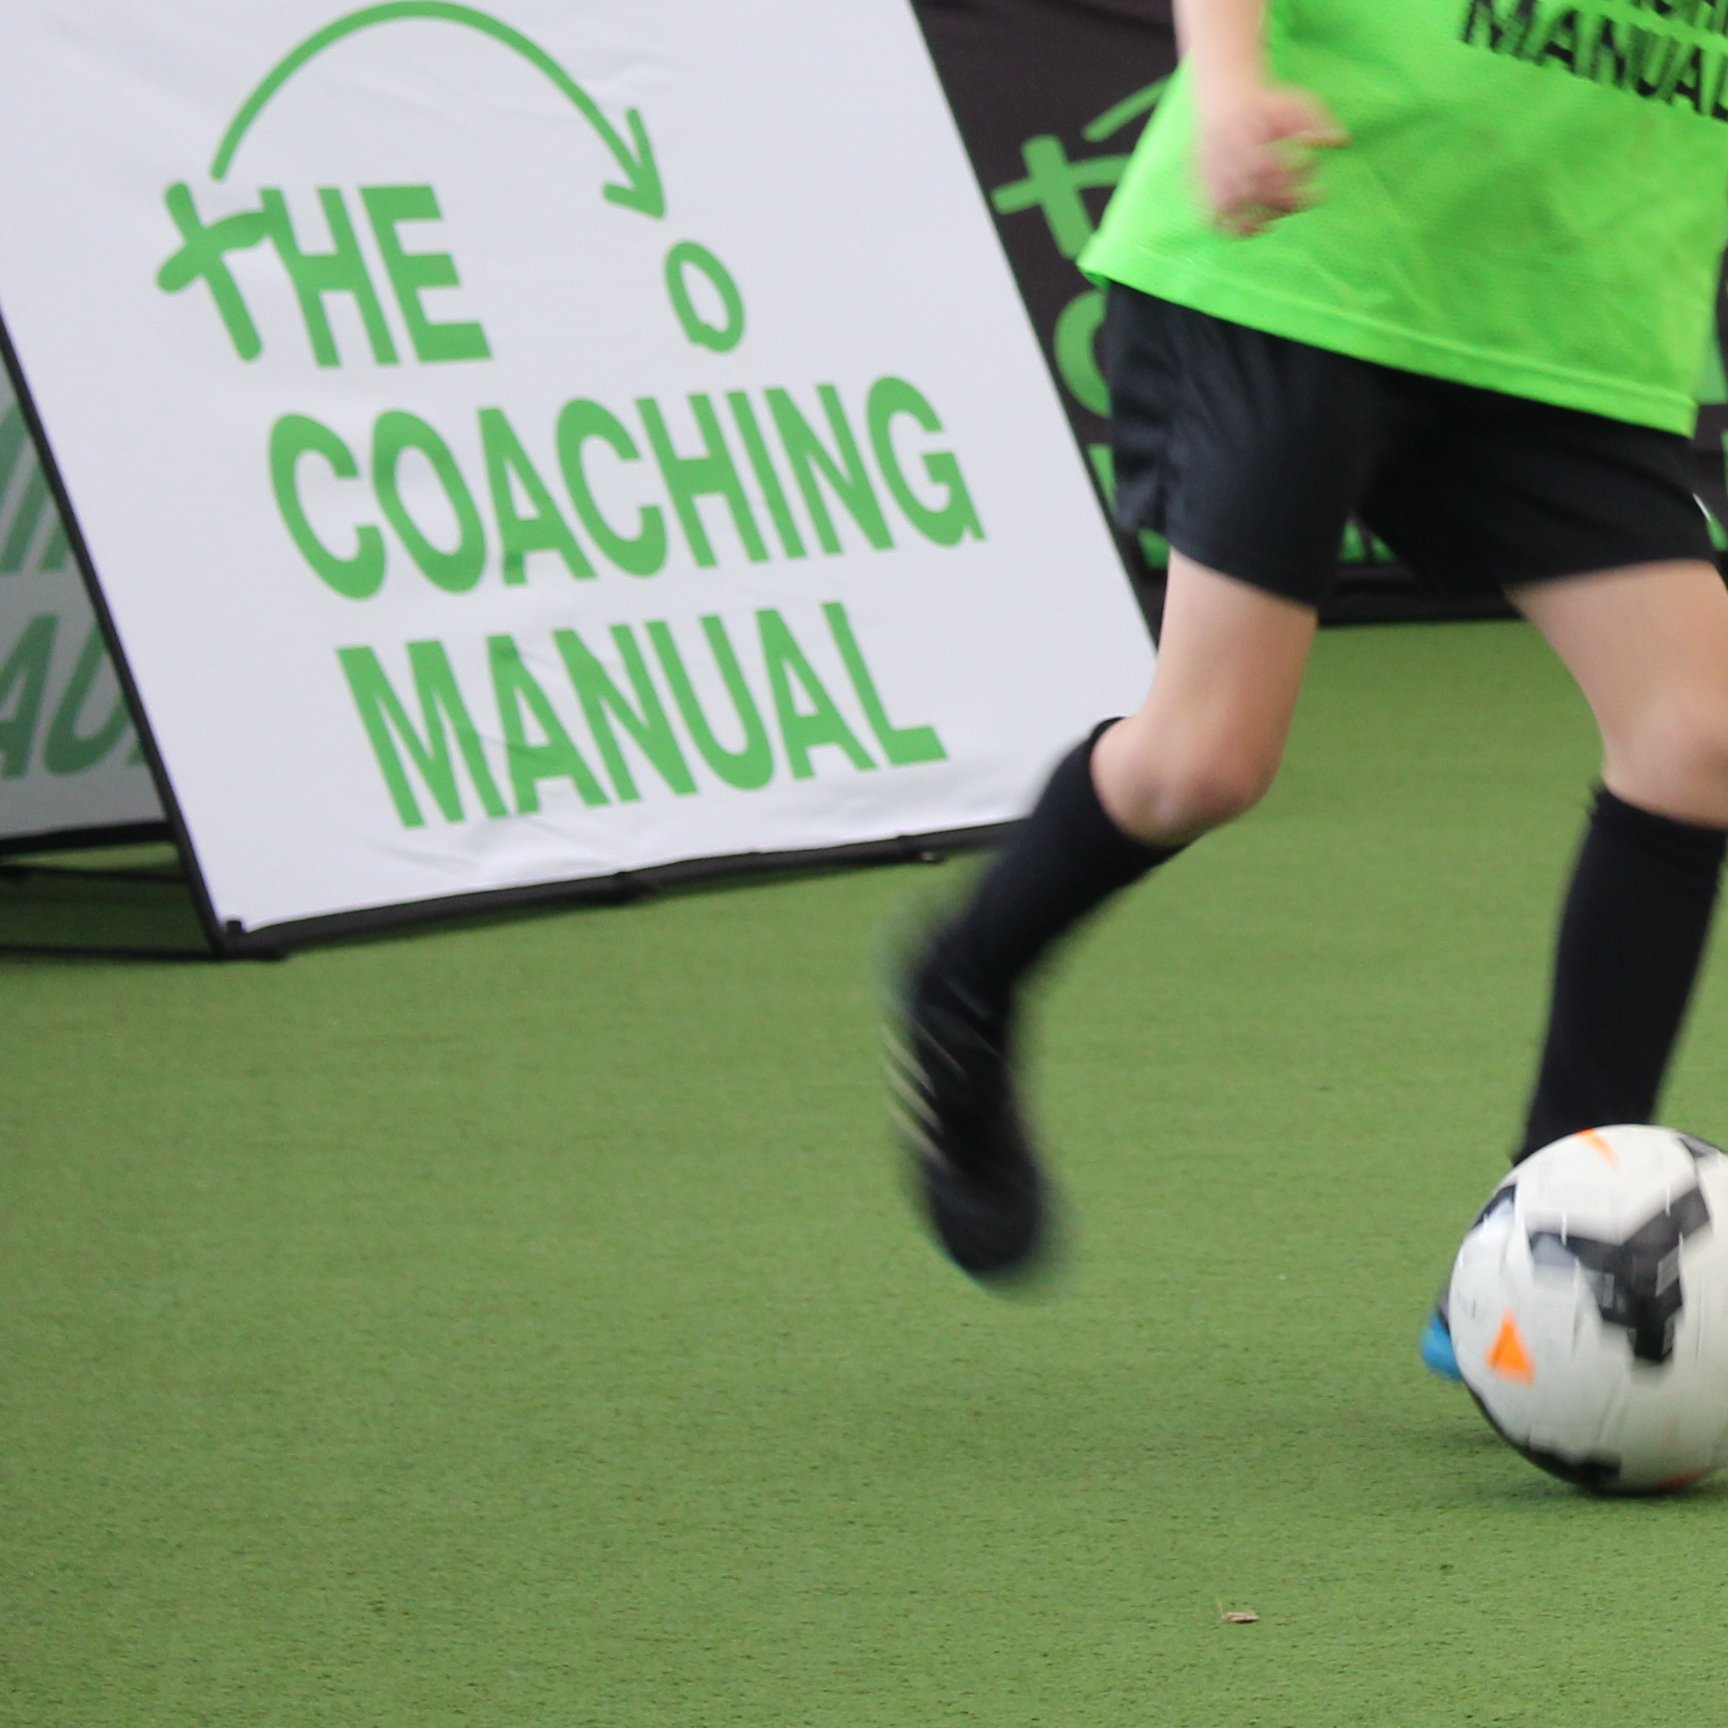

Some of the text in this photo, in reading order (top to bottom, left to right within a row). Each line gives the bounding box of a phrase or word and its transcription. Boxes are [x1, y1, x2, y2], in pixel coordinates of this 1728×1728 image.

[155, 182, 491, 368] THE
[268, 375, 986, 600] COACHING
[336, 601, 948, 829] MANUAL
